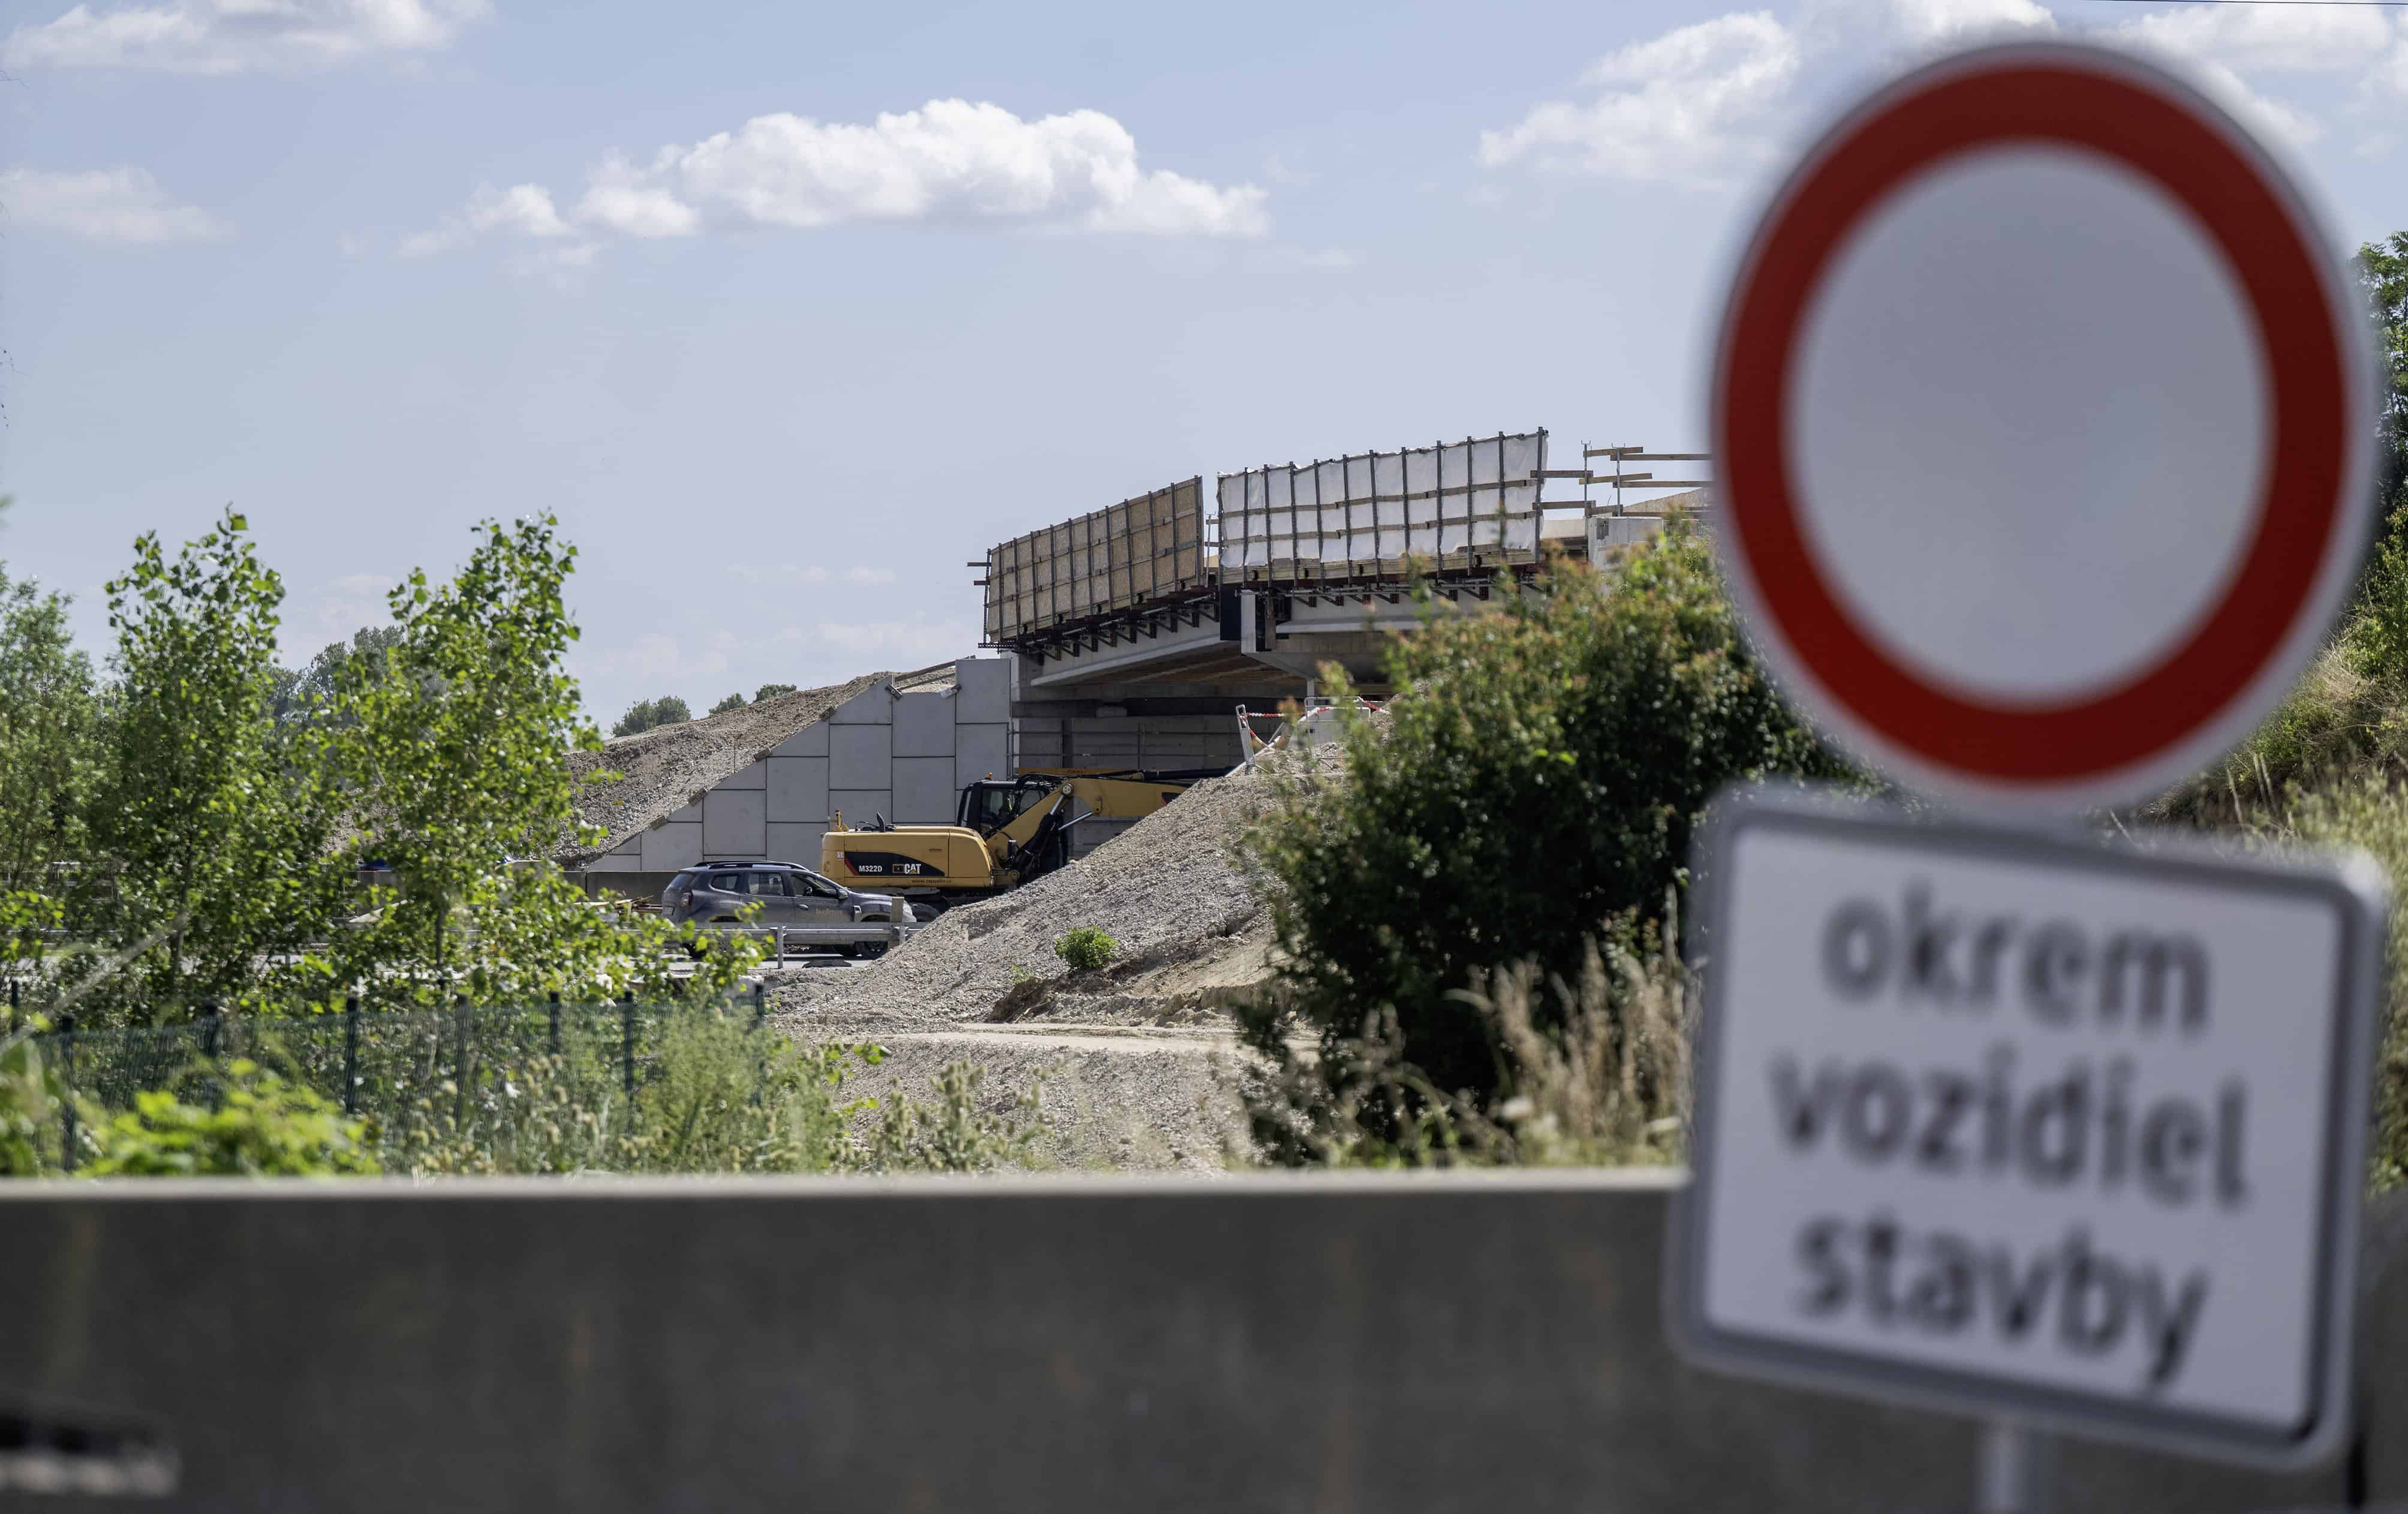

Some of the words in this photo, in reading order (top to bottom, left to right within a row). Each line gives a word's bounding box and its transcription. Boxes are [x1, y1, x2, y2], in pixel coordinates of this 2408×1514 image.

[904, 863, 922, 874] CAT
[1820, 877, 2211, 1037] okrem
[1769, 1043, 2250, 1208] vozidiel
[1796, 1216, 2209, 1390] stavby
